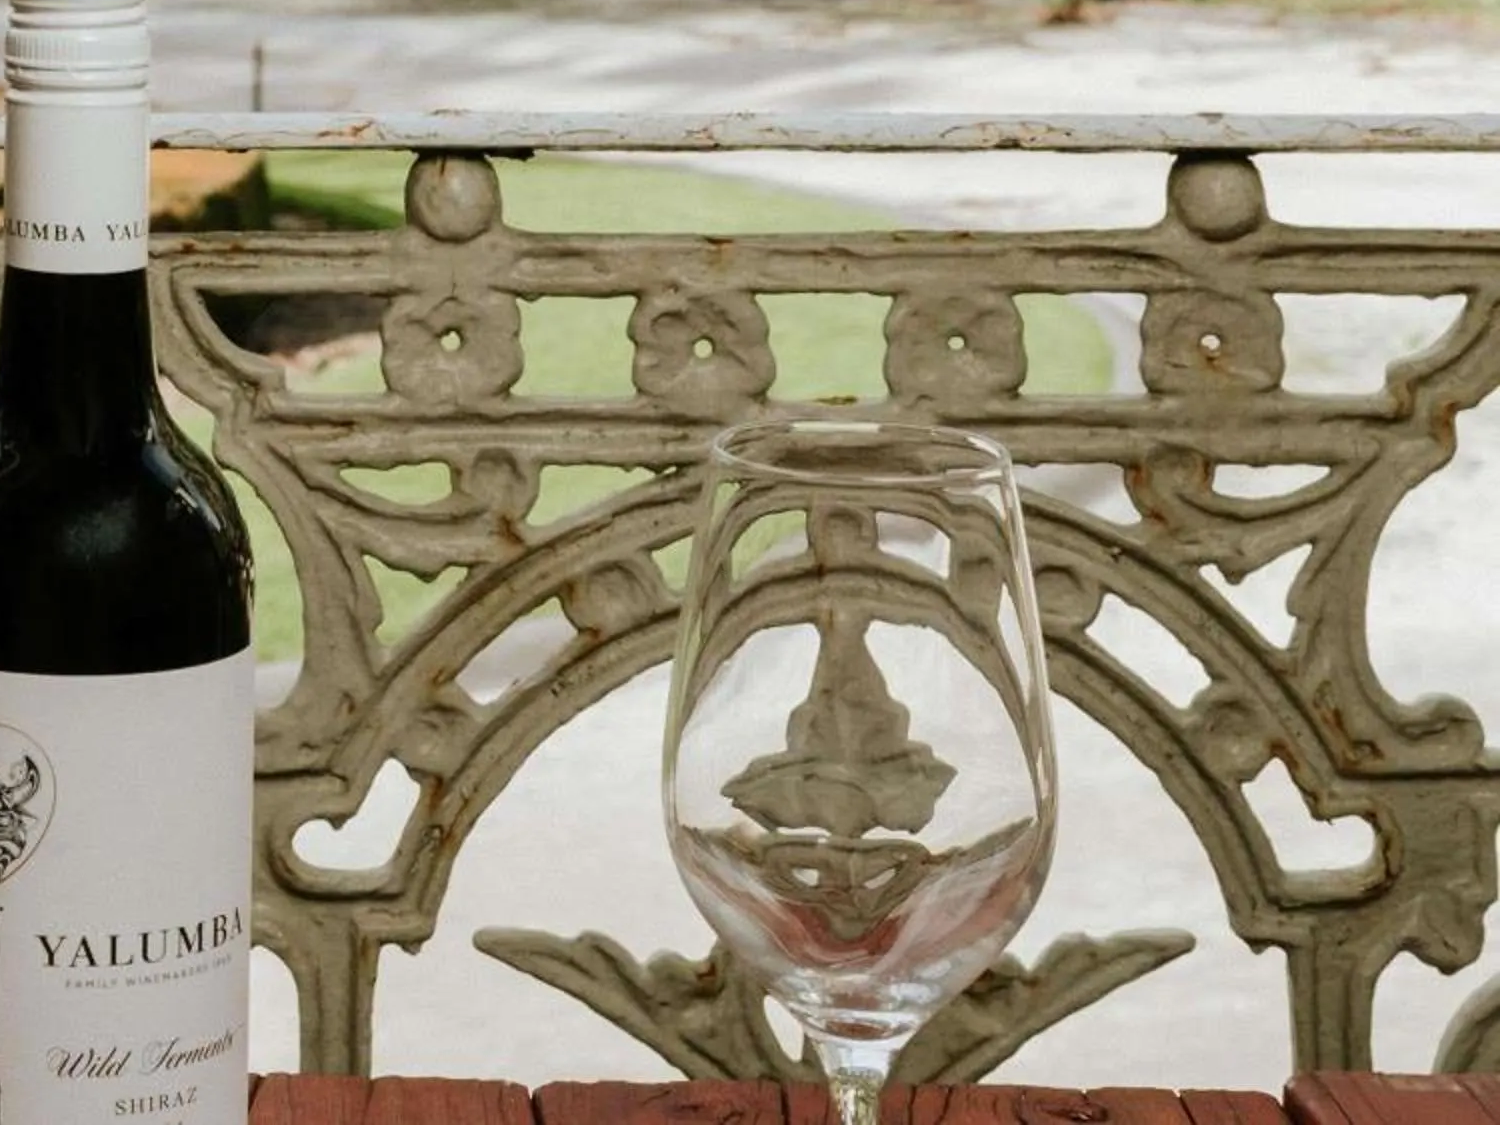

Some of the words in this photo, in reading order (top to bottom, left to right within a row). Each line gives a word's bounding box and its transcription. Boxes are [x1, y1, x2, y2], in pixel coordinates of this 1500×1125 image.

[36, 906, 243, 968] YALUMBA
[46, 1045, 132, 1079] Wild
[114, 1086, 198, 1116] SHIRAZ
